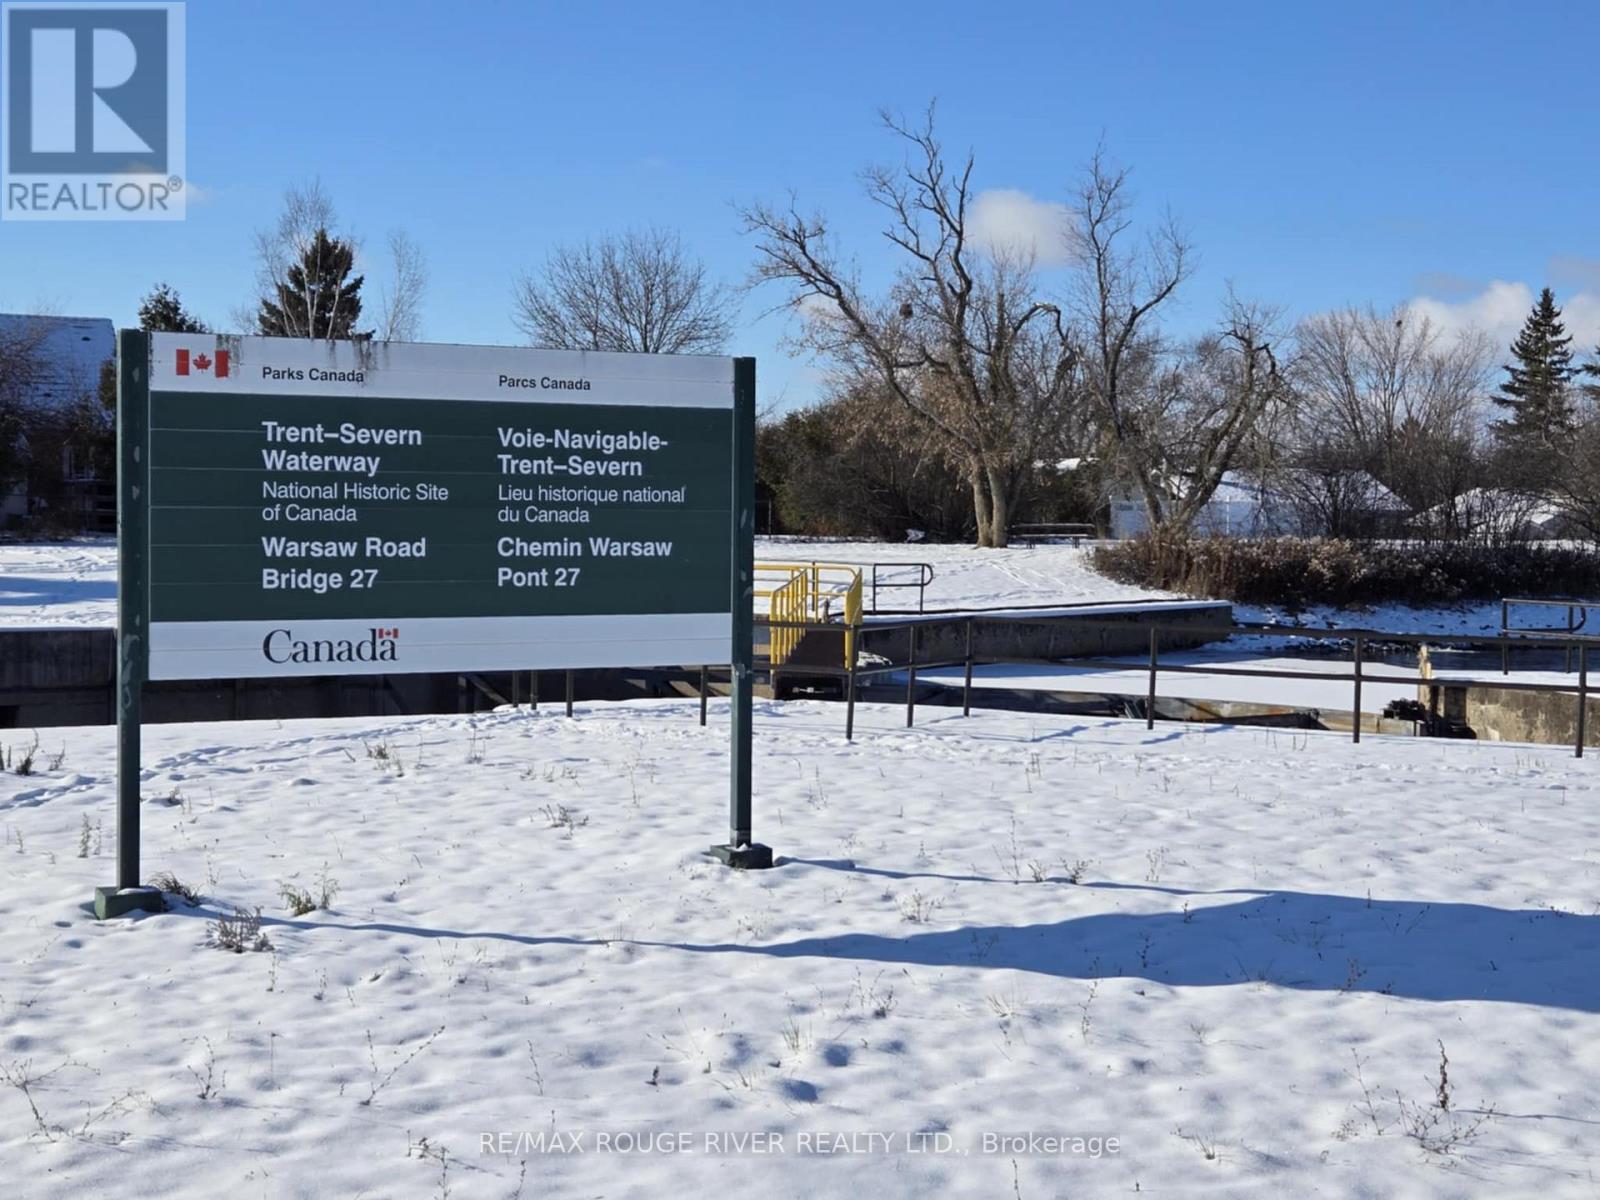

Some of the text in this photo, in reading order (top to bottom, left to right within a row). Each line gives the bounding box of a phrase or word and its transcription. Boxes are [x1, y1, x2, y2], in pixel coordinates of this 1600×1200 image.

[262, 366, 365, 383] Parks Canada
[498, 375, 591, 391] Parcs Canada
[497, 427, 669, 453] Voie-Navigable-
[262, 449, 381, 477] Waterway
[262, 481, 449, 501] National Historic Site
[498, 484, 685, 506] Lieu historique national
[262, 503, 357, 522] of Canada
[498, 506, 590, 523] du Canada
[262, 537, 427, 557] Warsaw Road
[497, 537, 673, 557] Chemin Warsaw
[262, 568, 378, 594] Bridge 27
[497, 568, 580, 587] Pont 27
[263, 628, 399, 664] Canada
